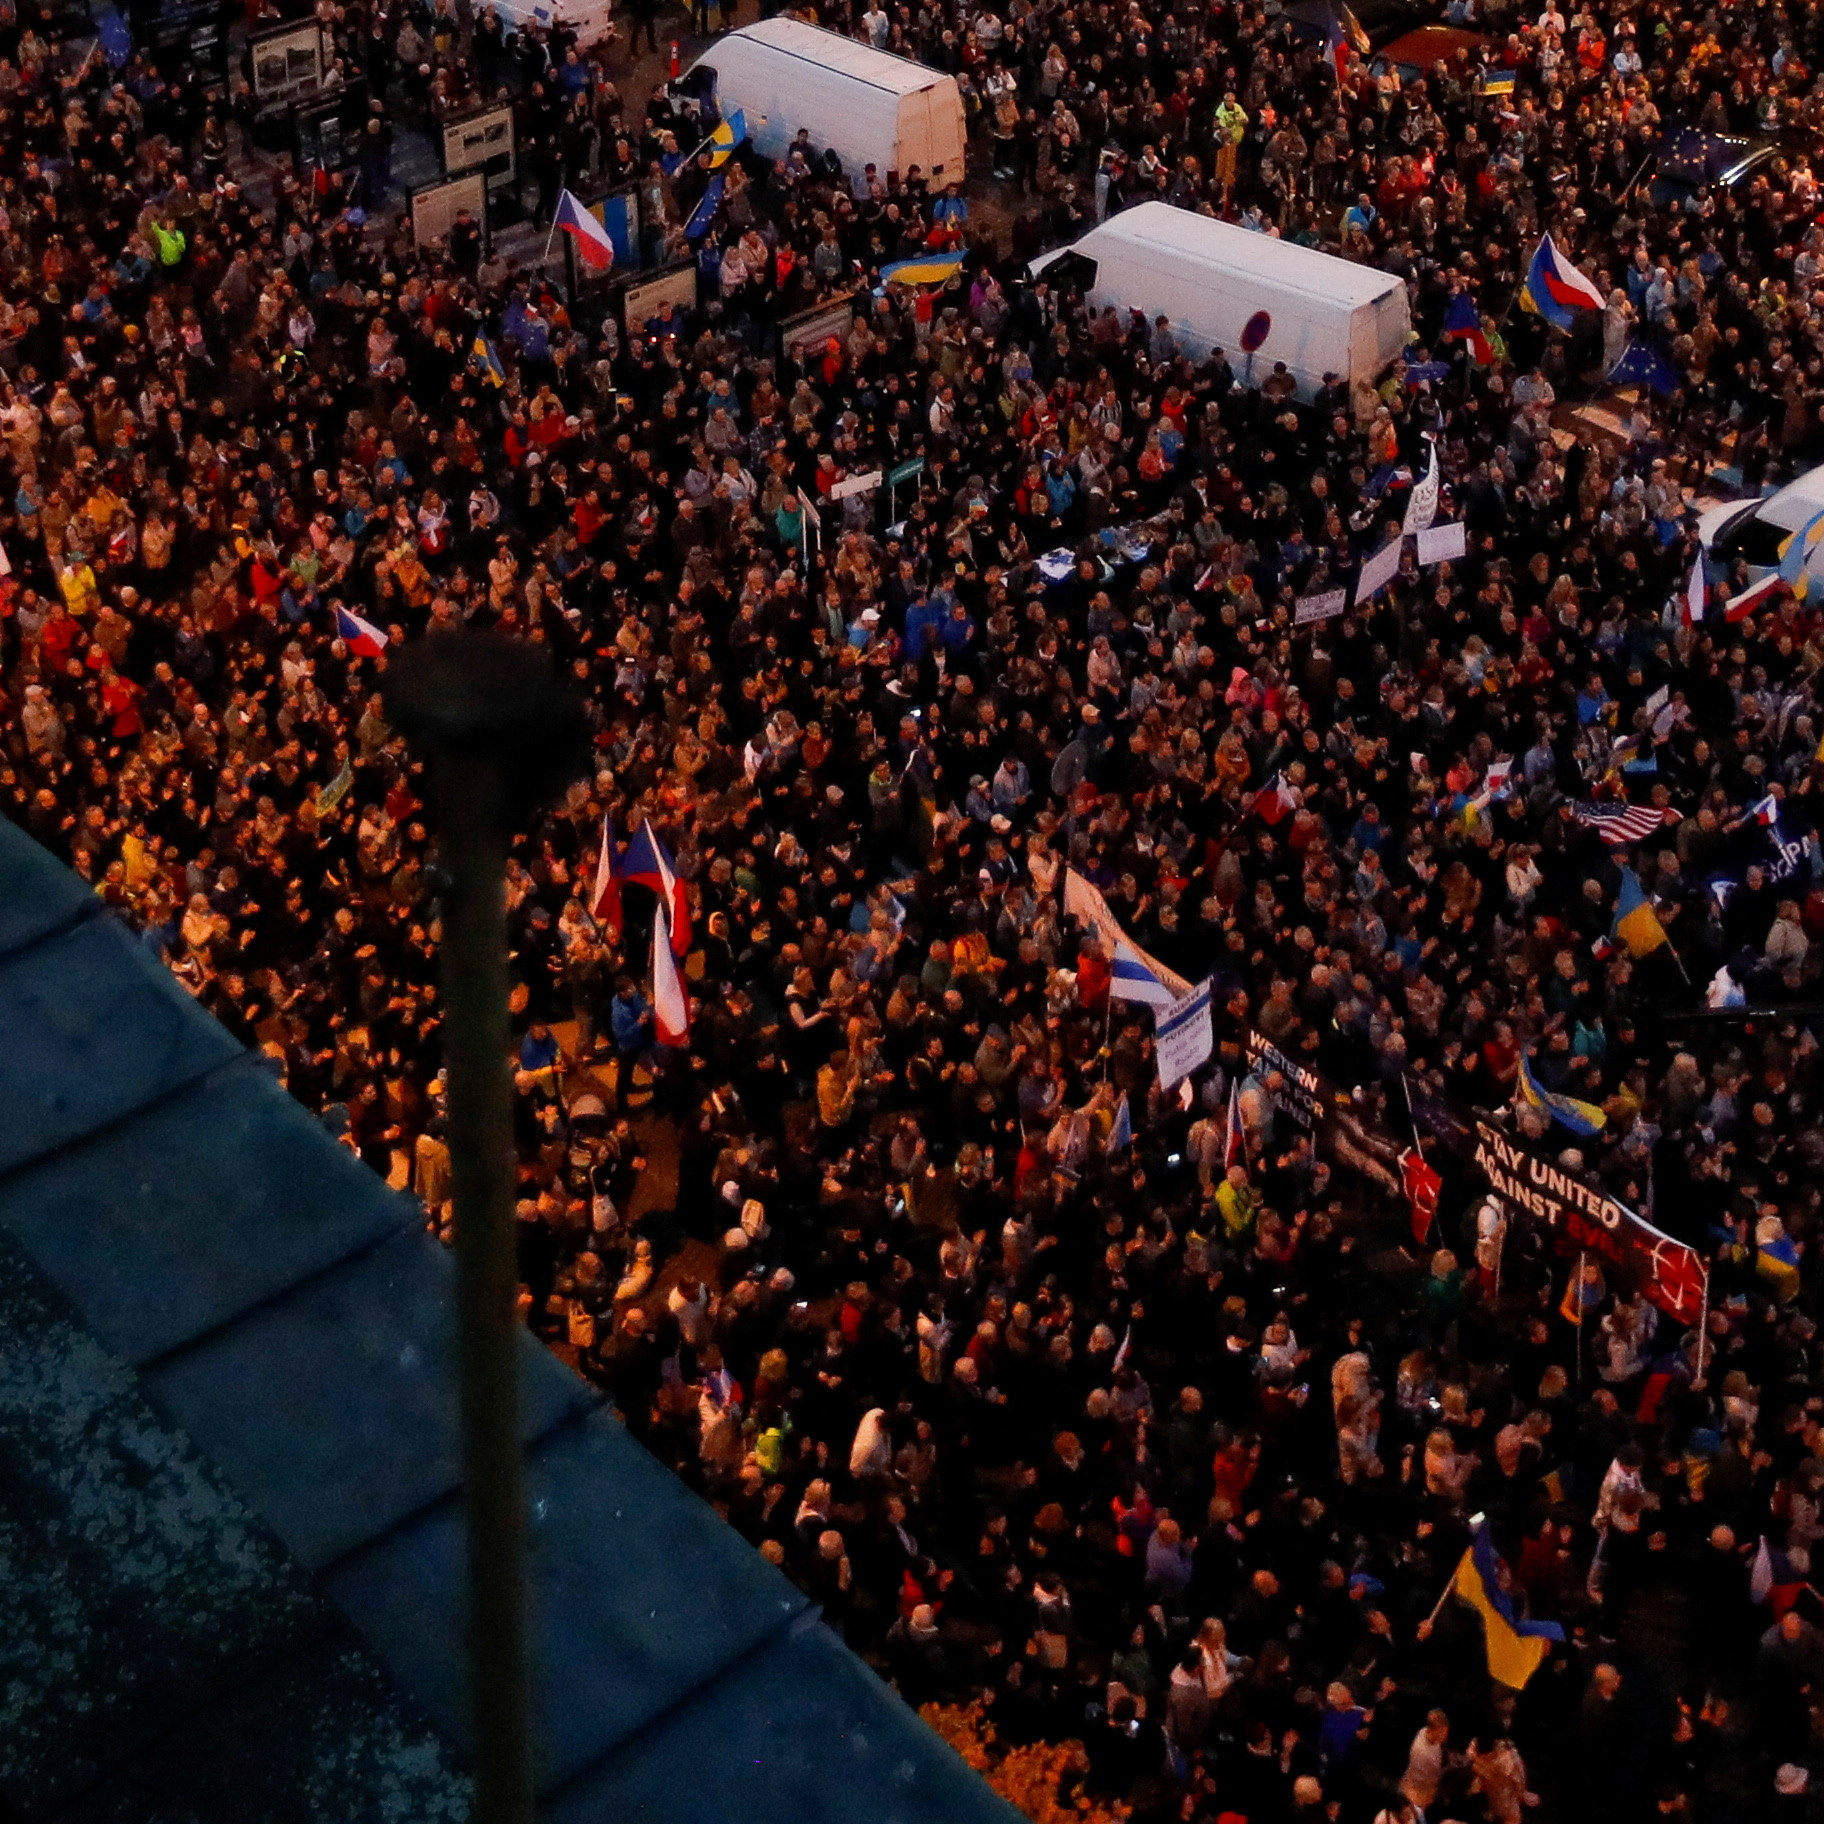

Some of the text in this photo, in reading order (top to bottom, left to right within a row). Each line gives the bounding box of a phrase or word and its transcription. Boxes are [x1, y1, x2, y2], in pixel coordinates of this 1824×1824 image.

[1250, 1029, 1318, 1093] WESTERN
[1474, 1142, 1563, 1225] AGAINST
[1476, 1120, 1621, 1229] STAY UNITED
